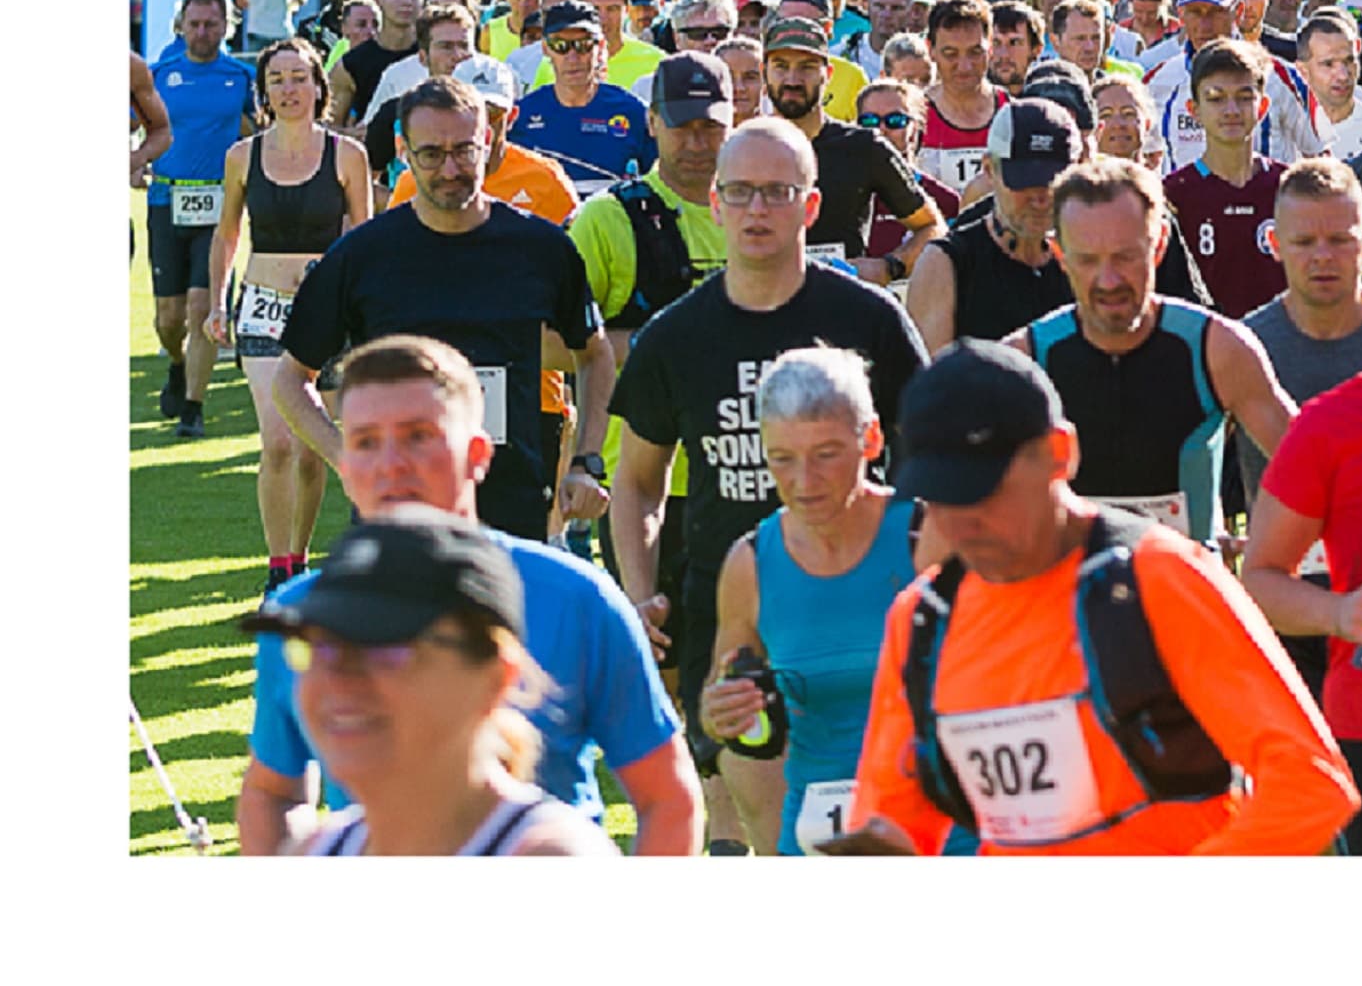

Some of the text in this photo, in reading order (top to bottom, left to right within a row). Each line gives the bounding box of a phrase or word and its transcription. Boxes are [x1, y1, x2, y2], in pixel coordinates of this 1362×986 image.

[181, 195, 214, 212] 259
[1199, 223, 1215, 255] 8
[968, 741, 1056, 798] 302
